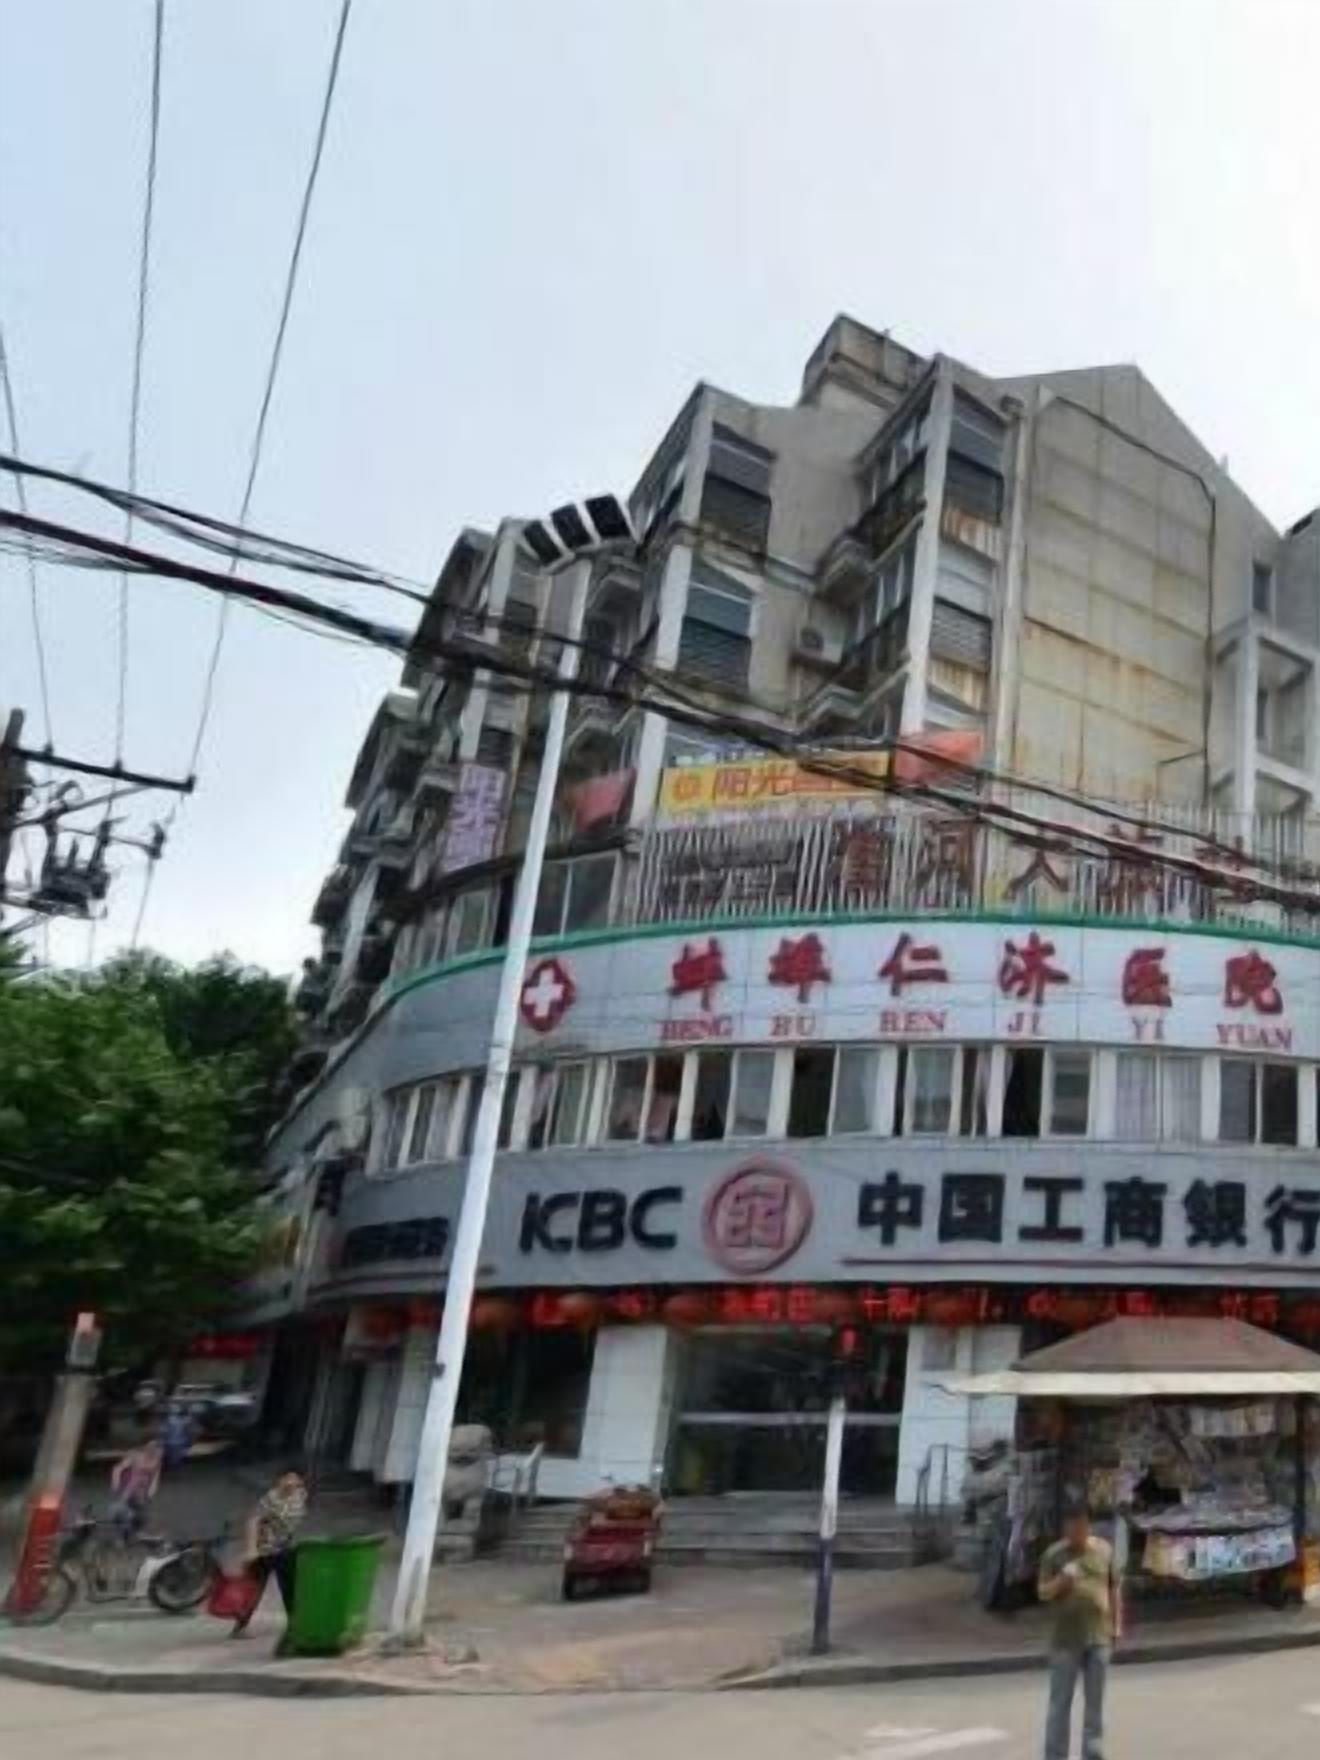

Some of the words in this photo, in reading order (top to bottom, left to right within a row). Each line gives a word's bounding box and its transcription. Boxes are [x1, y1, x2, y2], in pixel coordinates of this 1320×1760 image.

[770, 1015, 817, 1036] BU
[880, 1011, 949, 1033] REN
[1008, 1012, 1041, 1034] JI
[1131, 1015, 1165, 1040] YI
[1216, 1022, 1293, 1051] YUAN
[519, 1185, 683, 1254] ICBC
